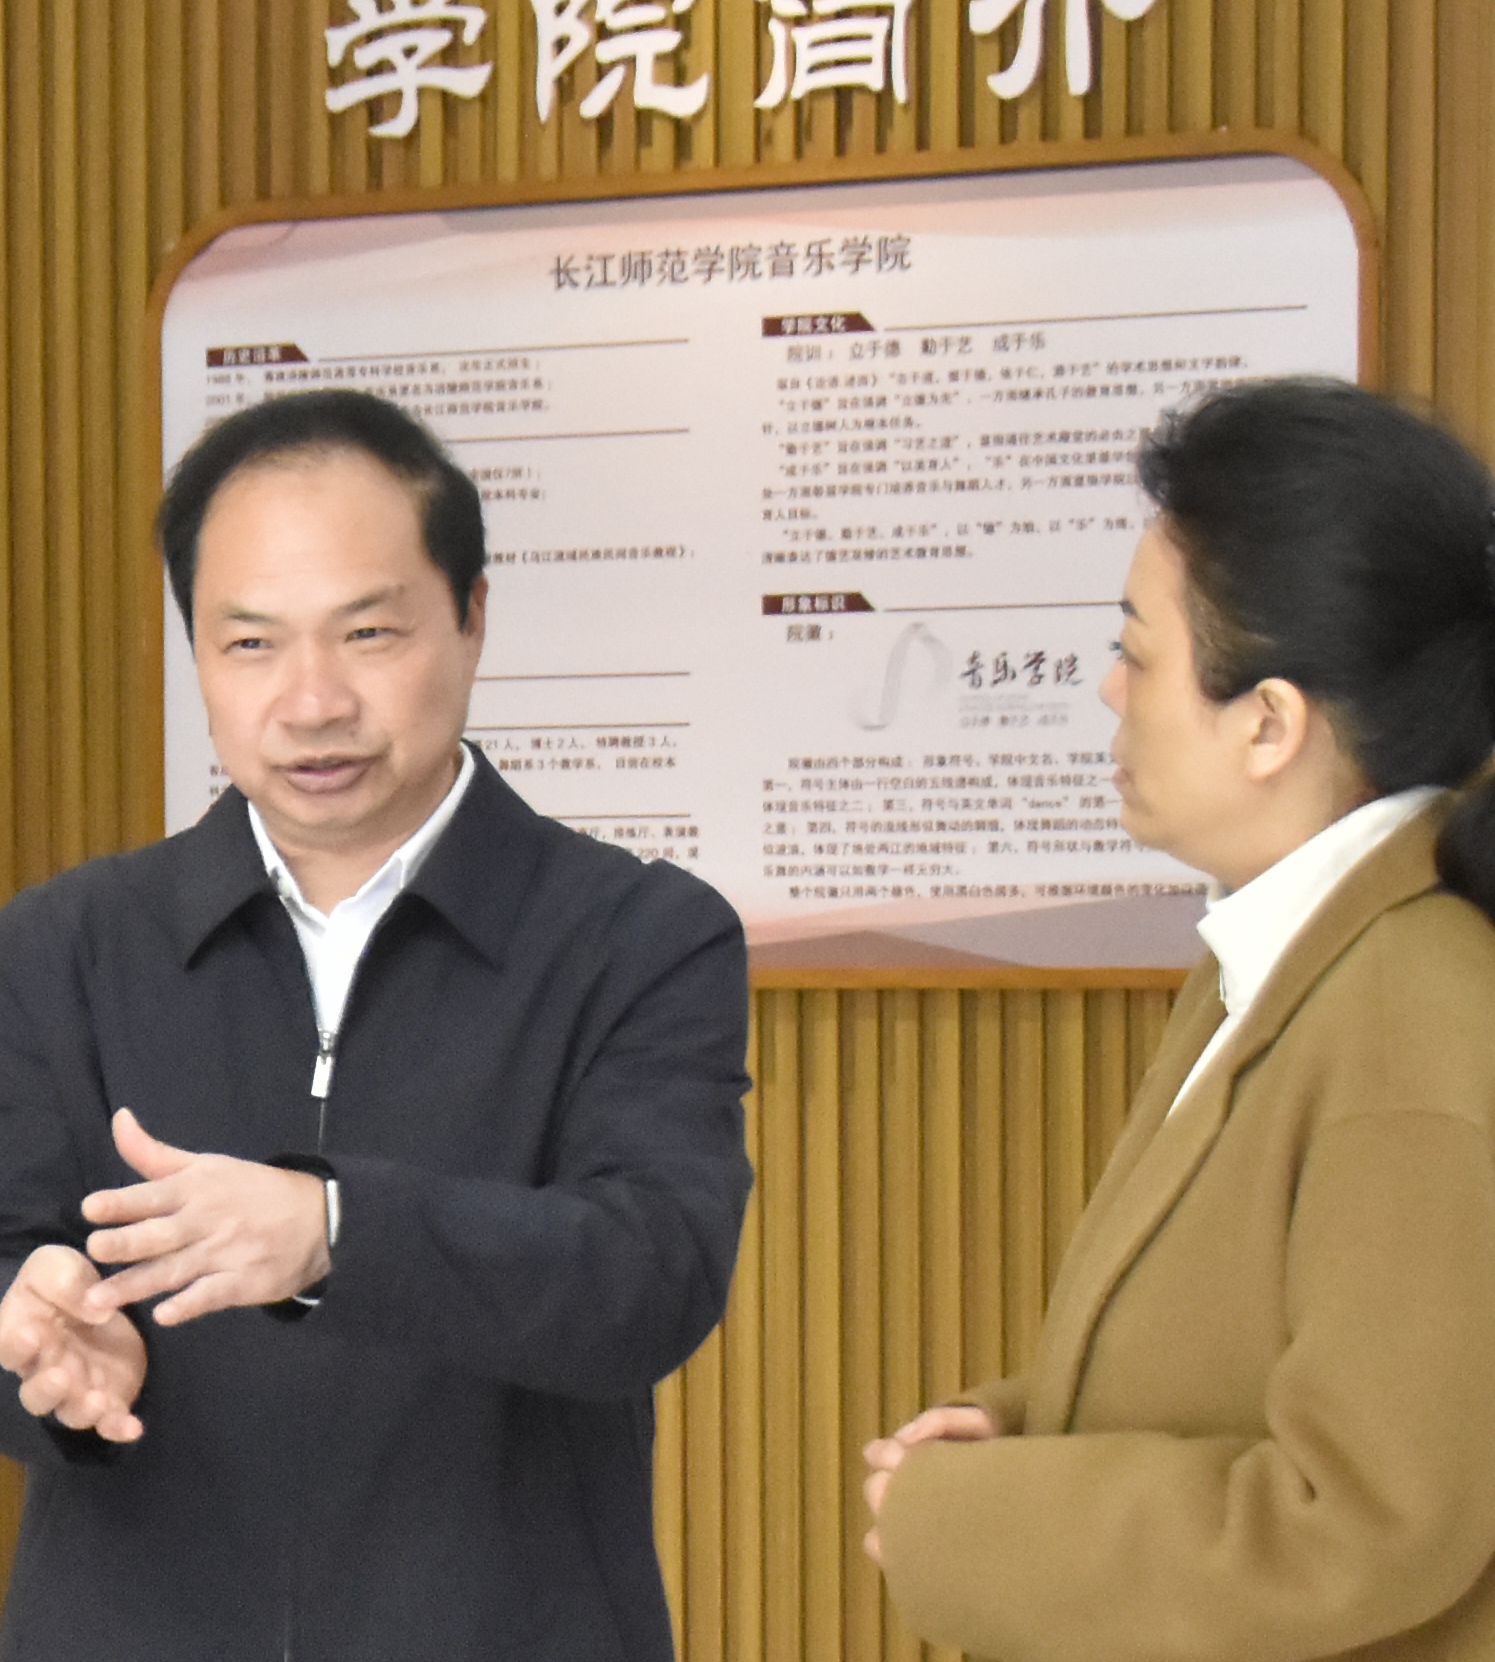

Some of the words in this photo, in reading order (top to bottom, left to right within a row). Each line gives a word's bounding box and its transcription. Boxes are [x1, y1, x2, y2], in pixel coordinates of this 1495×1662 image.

[548, 234, 912, 290] 长江师范学院音乐学院
[780, 313, 846, 335] 学院文化
[849, 339, 902, 360] 立于德
[920, 335, 974, 357] 勤于艺
[993, 331, 1047, 353] 成于乐
[959, 649, 1086, 689] 音乐学院
